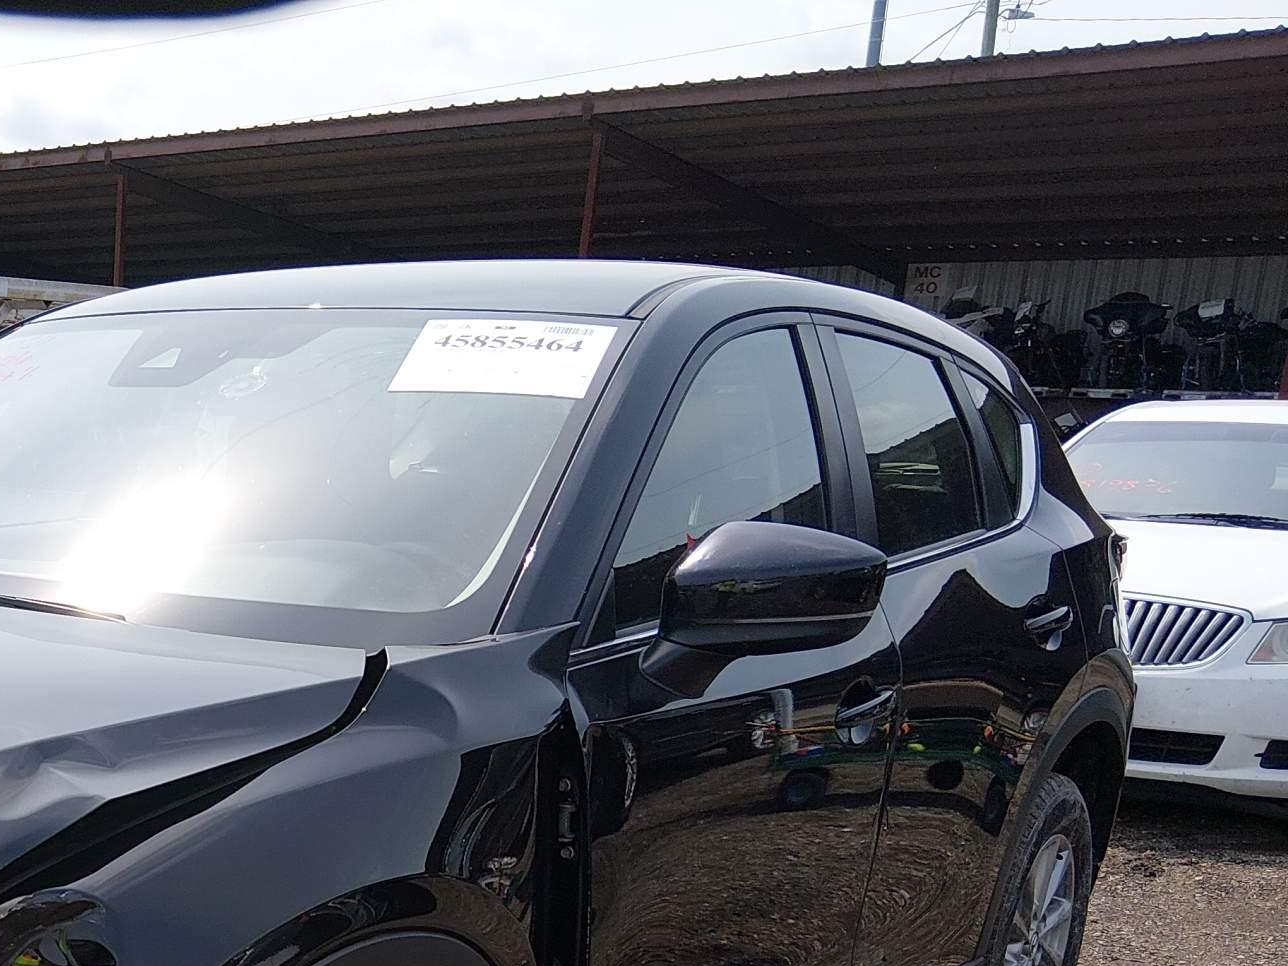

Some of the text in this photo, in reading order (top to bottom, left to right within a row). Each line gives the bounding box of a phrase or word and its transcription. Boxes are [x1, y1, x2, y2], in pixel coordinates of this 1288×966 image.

[914, 266, 942, 278] MC
[914, 281, 938, 294] 40
[434, 334, 584, 352] 45855464
